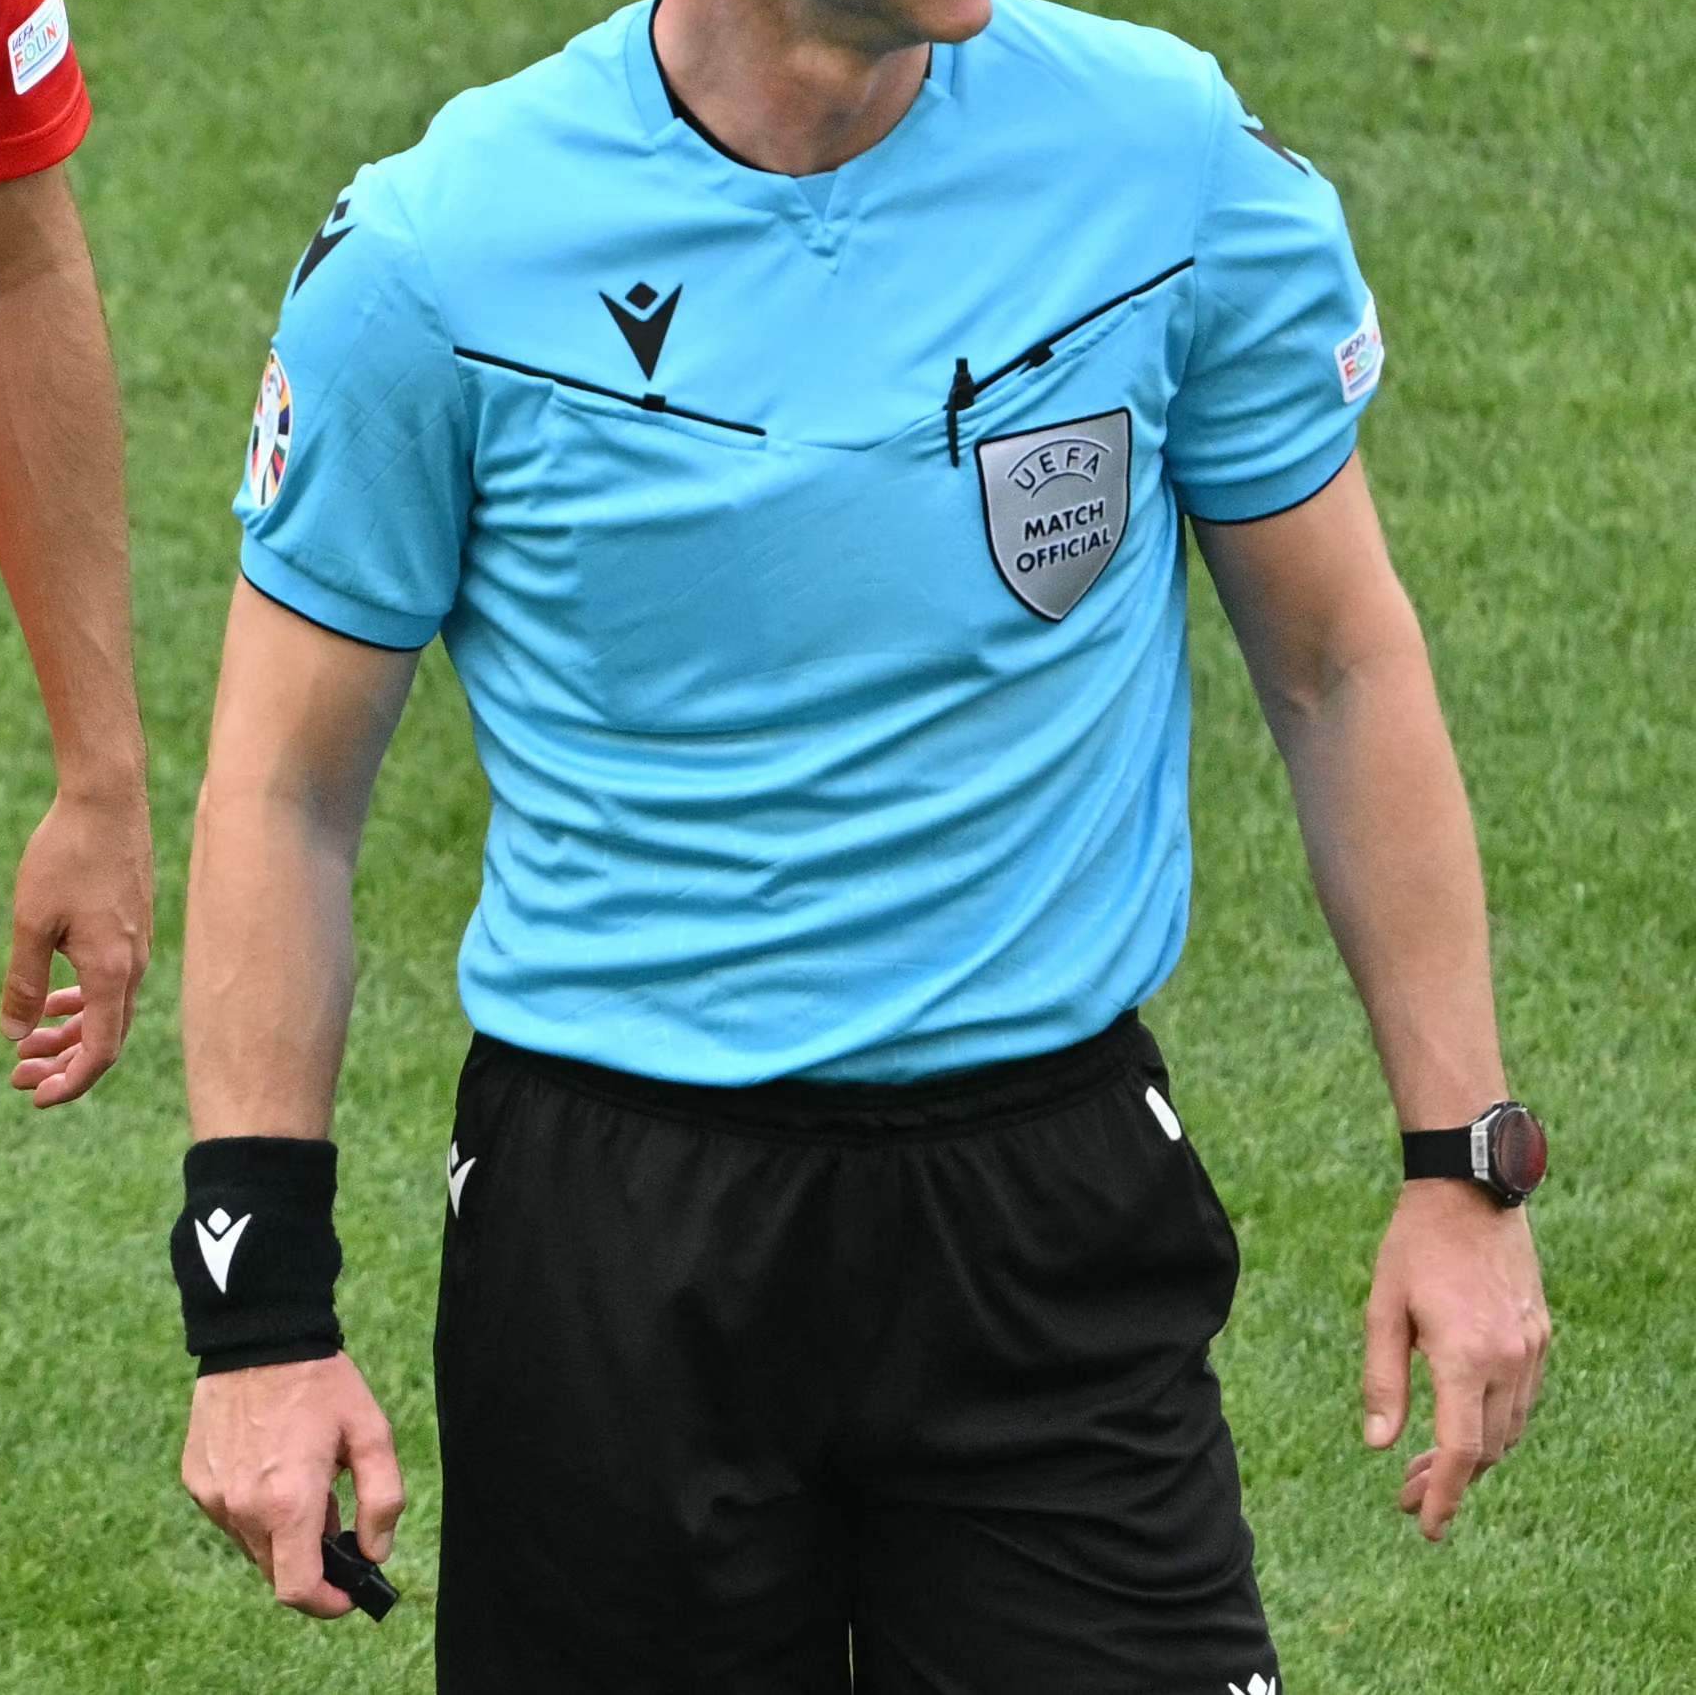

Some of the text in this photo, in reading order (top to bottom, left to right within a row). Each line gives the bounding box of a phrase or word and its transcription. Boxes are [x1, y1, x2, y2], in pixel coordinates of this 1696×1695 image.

[1014, 446, 1100, 491] UEFA
[1024, 500, 1105, 542] MATCH
[1016, 527, 1112, 573] OFFICIAL
